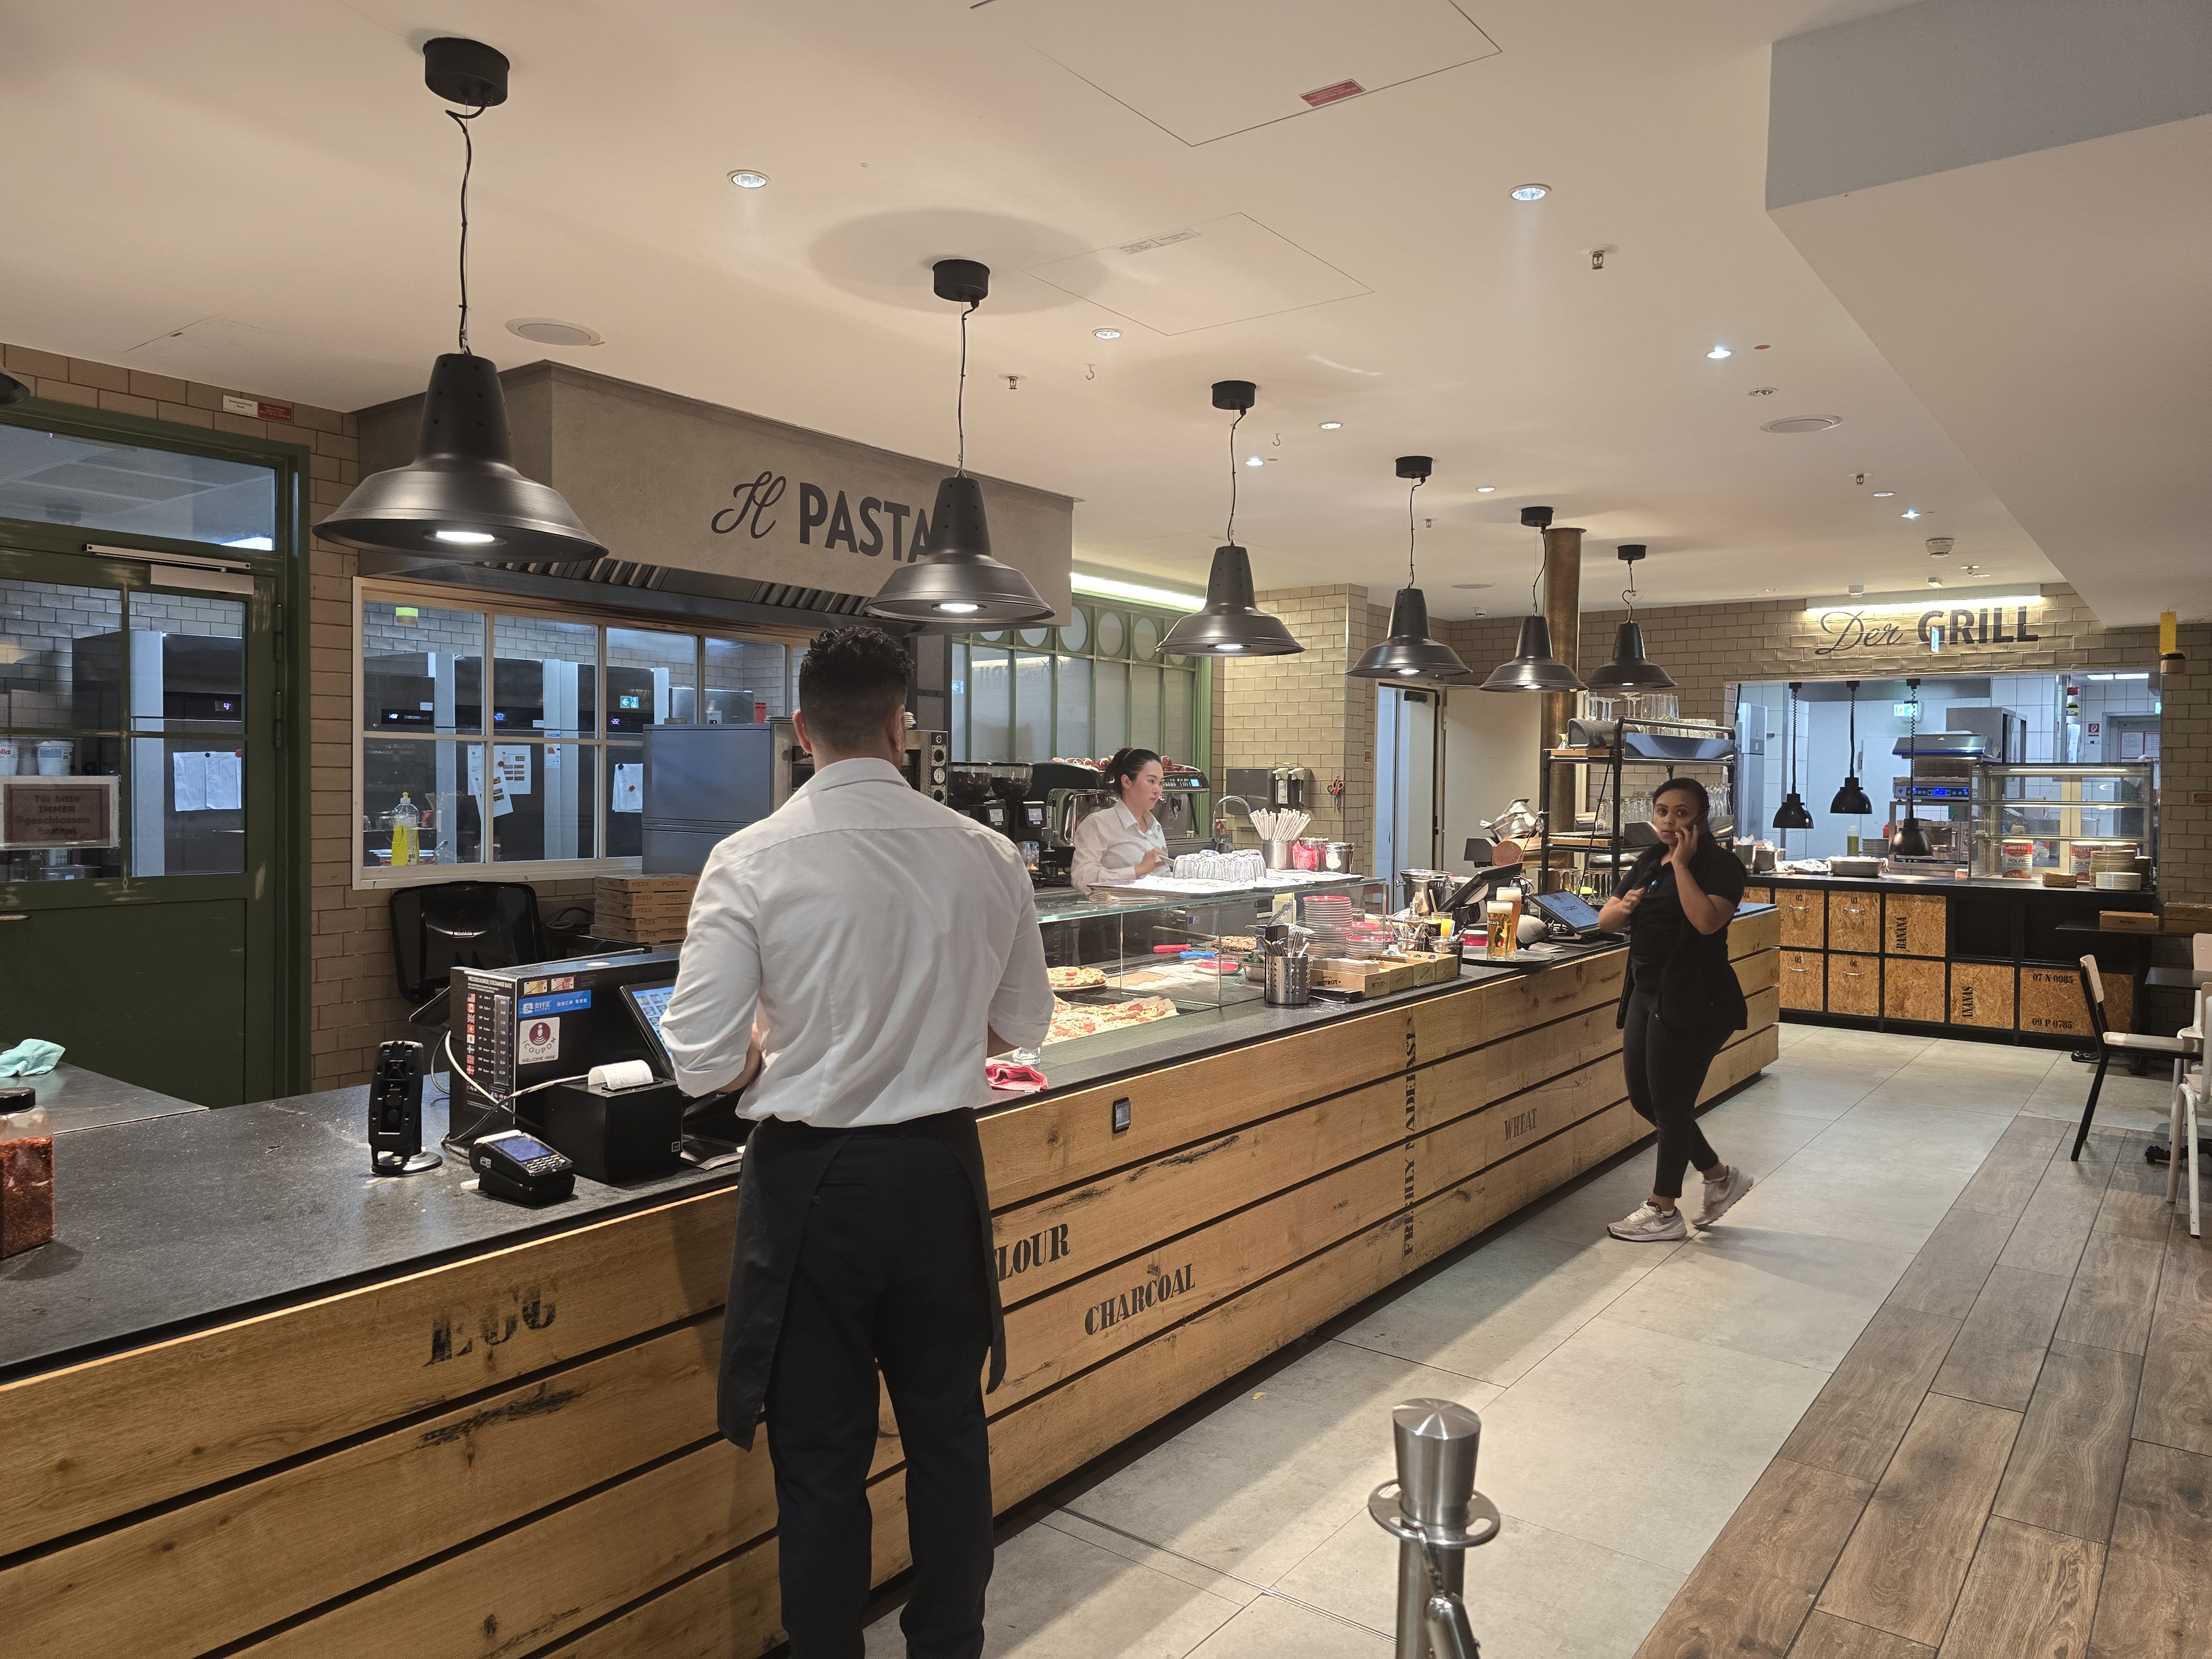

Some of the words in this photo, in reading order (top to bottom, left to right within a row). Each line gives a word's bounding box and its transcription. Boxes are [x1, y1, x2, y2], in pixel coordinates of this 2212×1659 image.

[800, 482, 931, 563] PASTA
[1815, 611, 1903, 655] Der
[1917, 606, 2039, 645] GRILL
[24, 816, 91, 826] geschlossen
[39, 805, 76, 813] IMMER
[1896, 916, 1907, 950] BANANA
[2033, 973, 2042, 982] 07
[2053, 974, 2074, 984] 0985
[1962, 986, 1973, 1020] ANANAS
[2032, 1018, 2042, 1026] 09
[2044, 1019, 2051, 1027] P
[2052, 1020, 2073, 1029] 0785
[523, 1037, 556, 1055] ICOUPON
[1504, 1108, 1537, 1142] WHEAT
[994, 1223, 1071, 1282] LOUR
[1084, 1263, 1196, 1335] CHARCOAL
